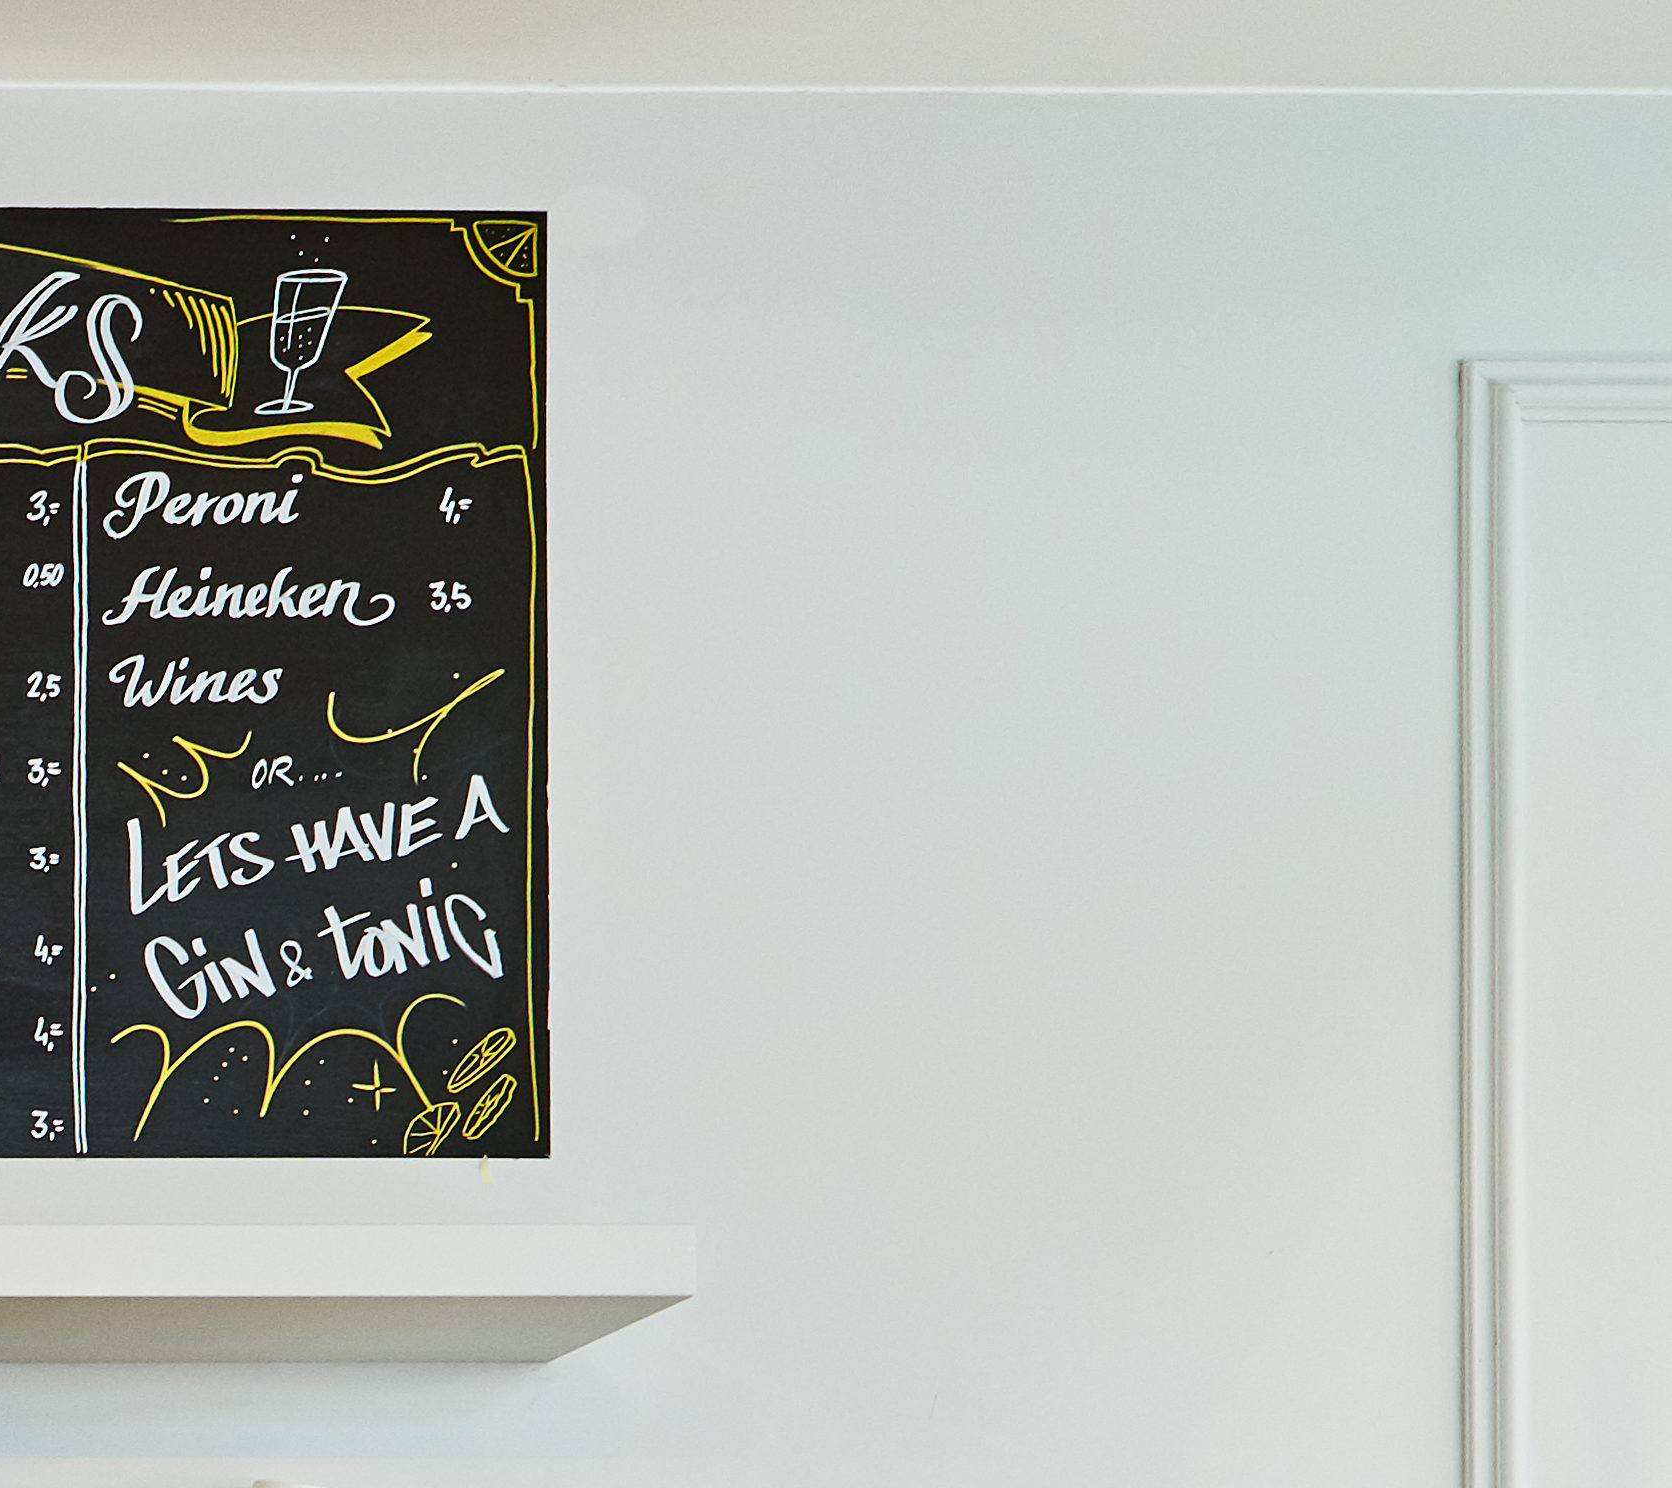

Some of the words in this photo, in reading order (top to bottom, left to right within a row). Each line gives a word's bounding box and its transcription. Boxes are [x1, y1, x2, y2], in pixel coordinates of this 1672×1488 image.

[102, 470, 304, 540] Peroni
[101, 565, 396, 627] Heineken
[26, 670, 62, 703] 2,5
[108, 654, 284, 708] Wines
[284, 796, 443, 873] HAVE
[454, 774, 510, 840] A
[279, 939, 313, 988] &
